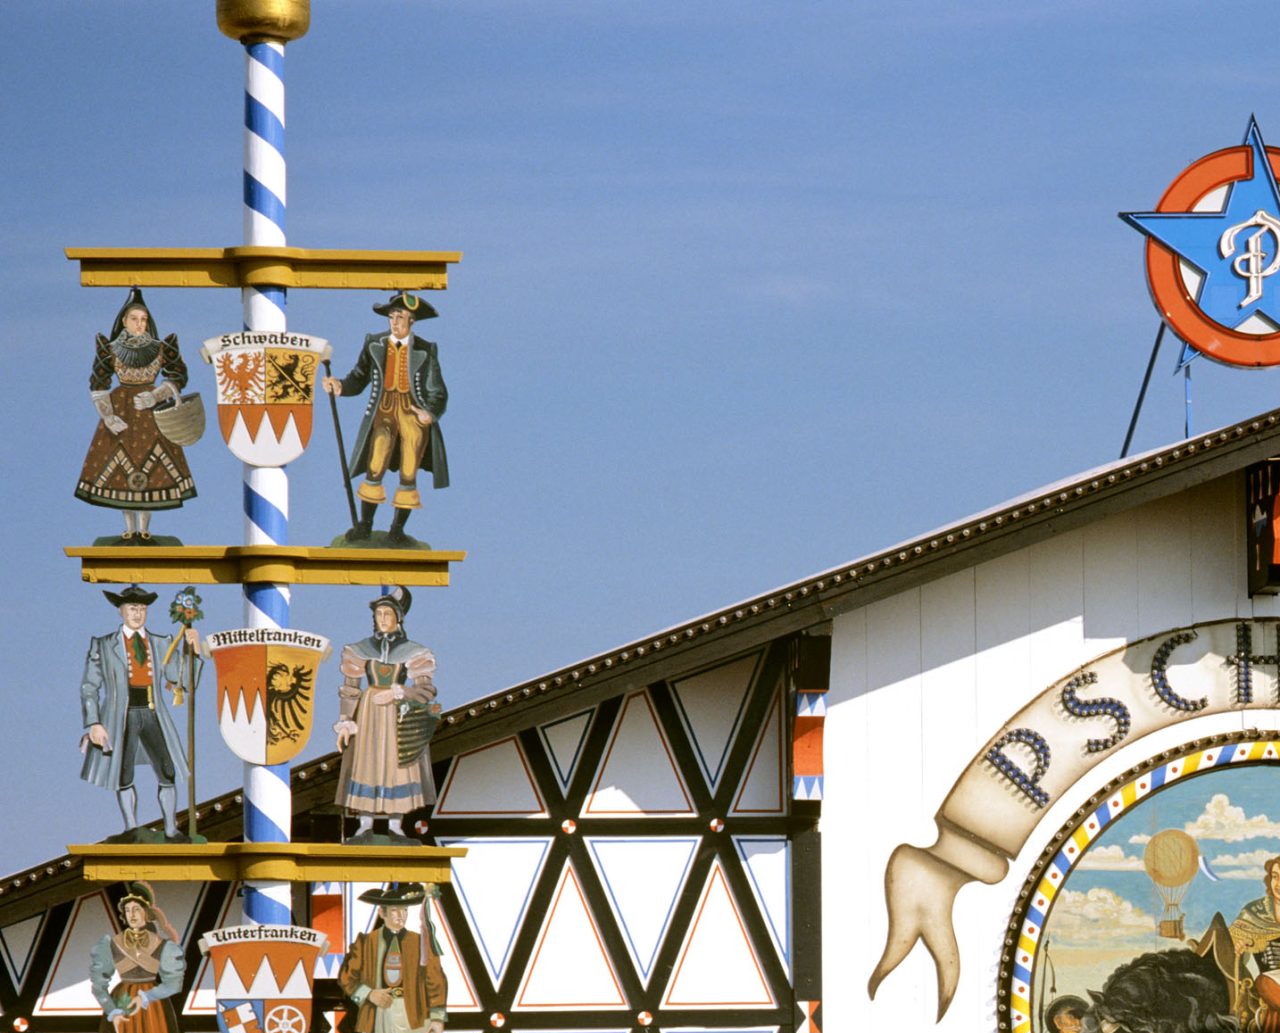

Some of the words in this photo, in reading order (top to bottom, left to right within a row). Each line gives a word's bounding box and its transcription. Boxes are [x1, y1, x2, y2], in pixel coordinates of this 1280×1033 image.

[220, 332, 311, 349] Schwaben
[212, 628, 322, 648] Mittelfranken
[211, 925, 318, 942] Unterfranken
